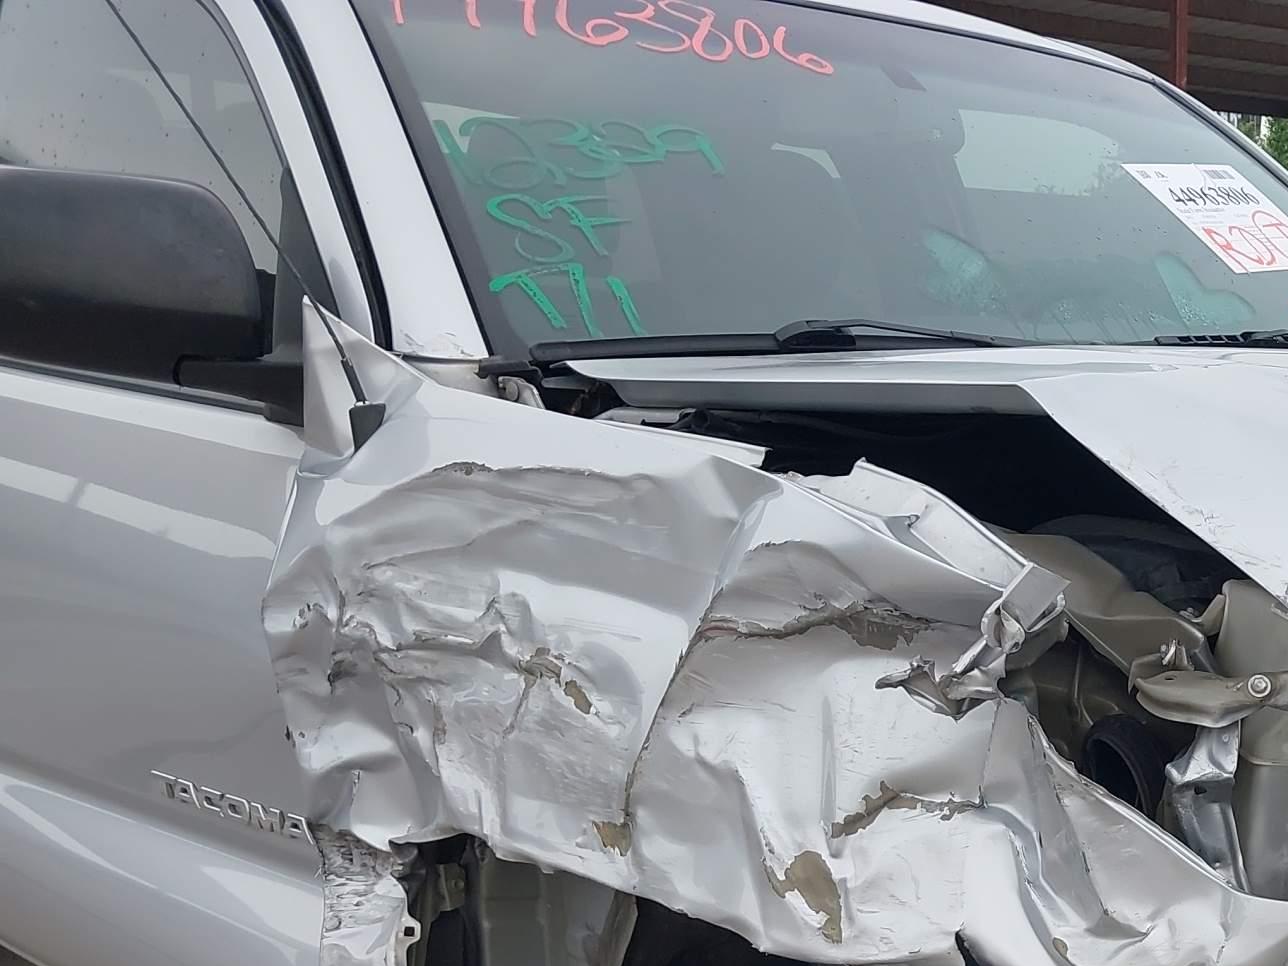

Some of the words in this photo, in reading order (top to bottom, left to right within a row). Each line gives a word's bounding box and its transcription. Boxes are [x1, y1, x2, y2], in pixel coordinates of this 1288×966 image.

[393, 0, 834, 74] 63806
[1168, 186, 1261, 206] 44963806
[151, 769, 315, 846] TACOMA
